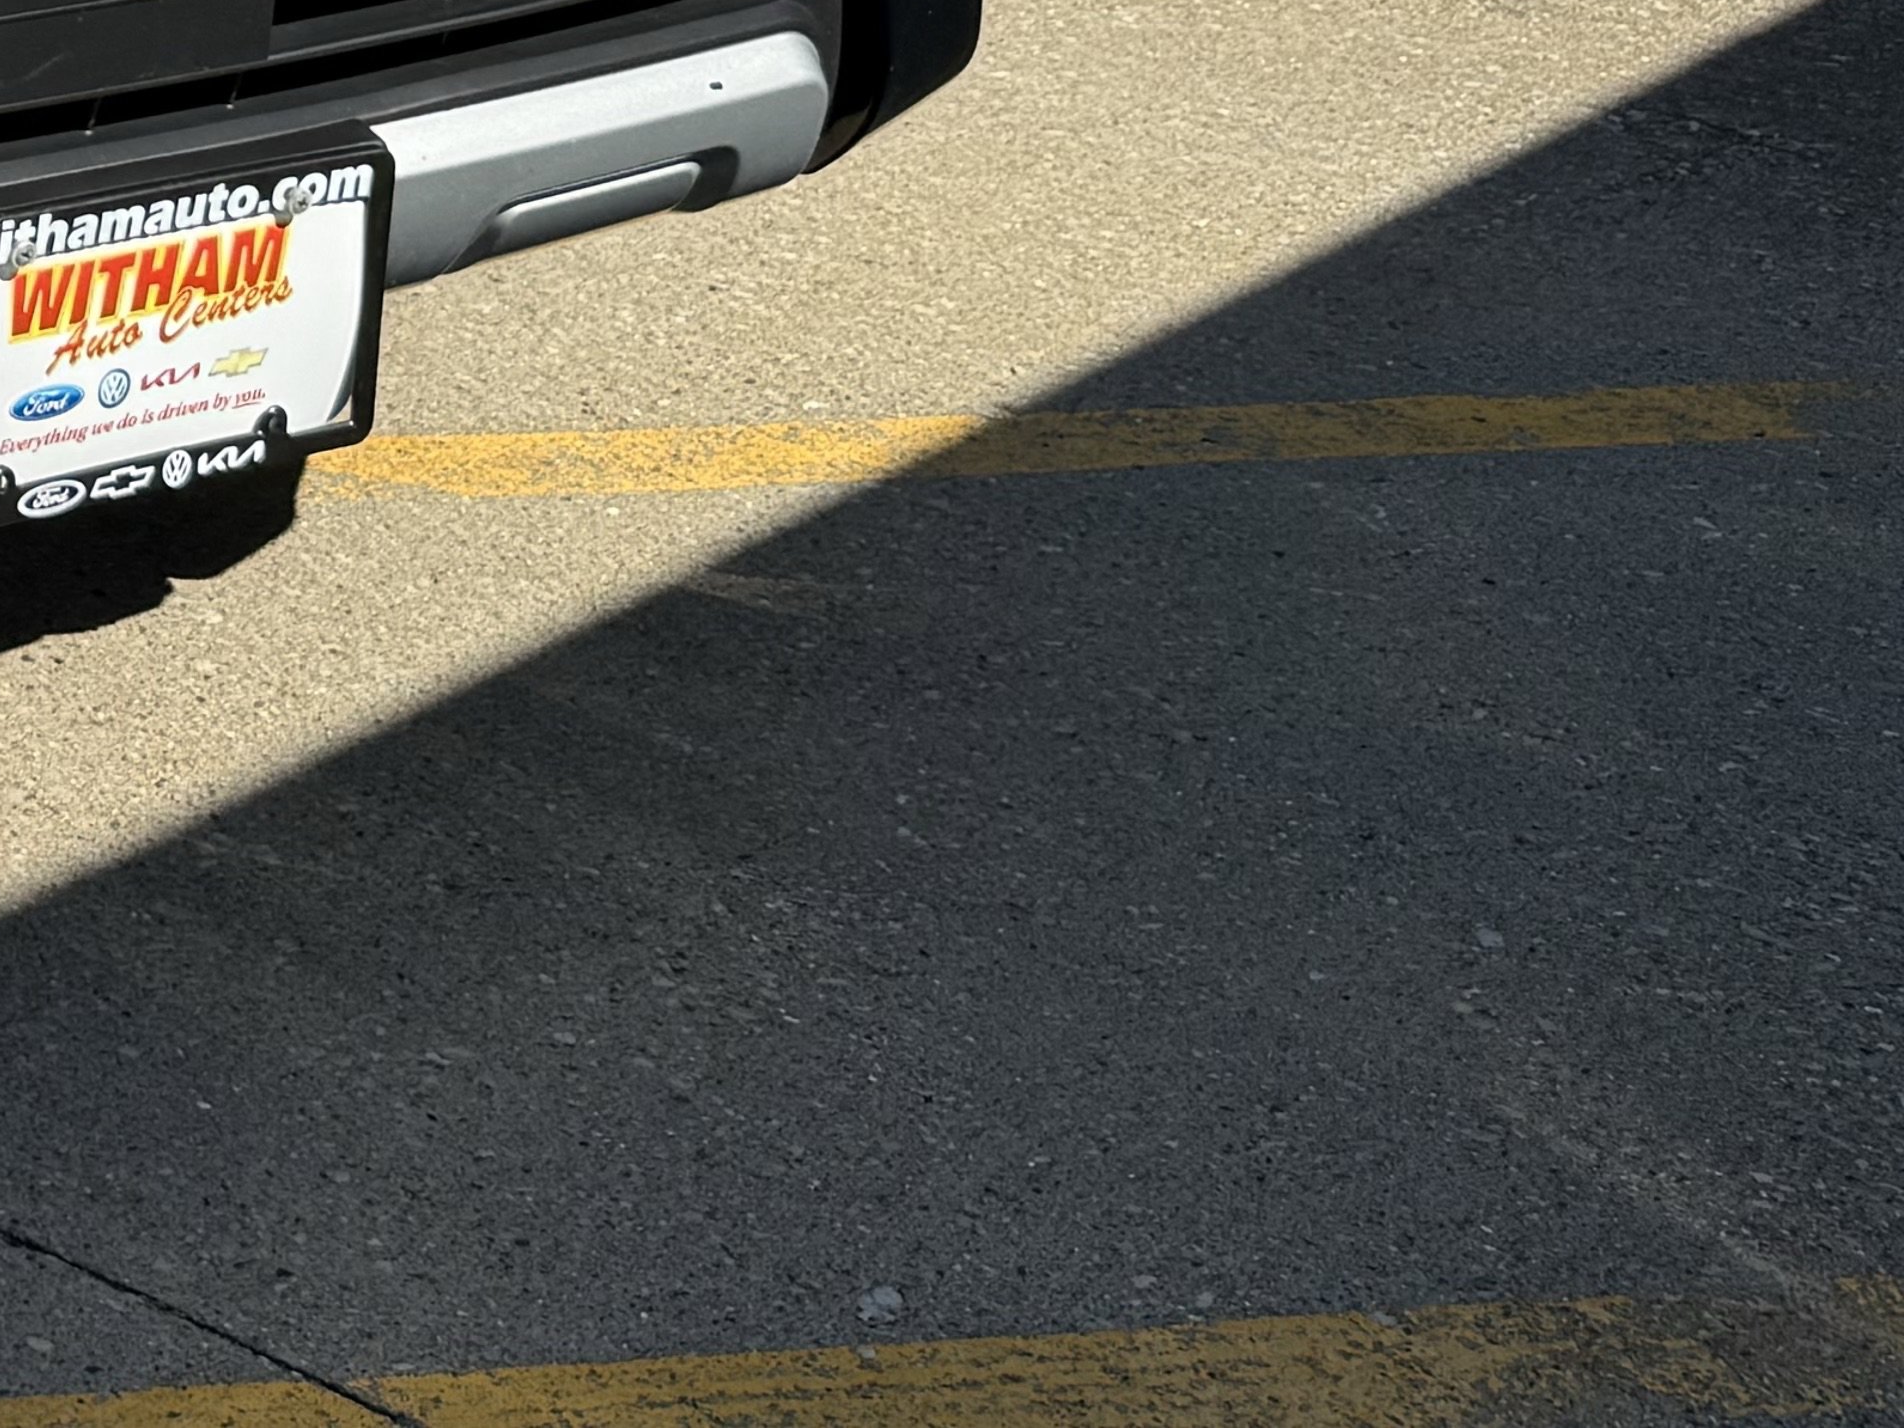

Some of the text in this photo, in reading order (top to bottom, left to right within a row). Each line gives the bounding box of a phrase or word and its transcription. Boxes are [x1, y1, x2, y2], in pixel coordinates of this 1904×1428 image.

[10, 225, 288, 341] WITHAM
[46, 274, 293, 375] Auto Centers
[92, 421, 114, 436] we
[117, 413, 137, 429] do
[142, 410, 155, 425] is
[157, 400, 209, 421] driven
[213, 392, 232, 410] by
